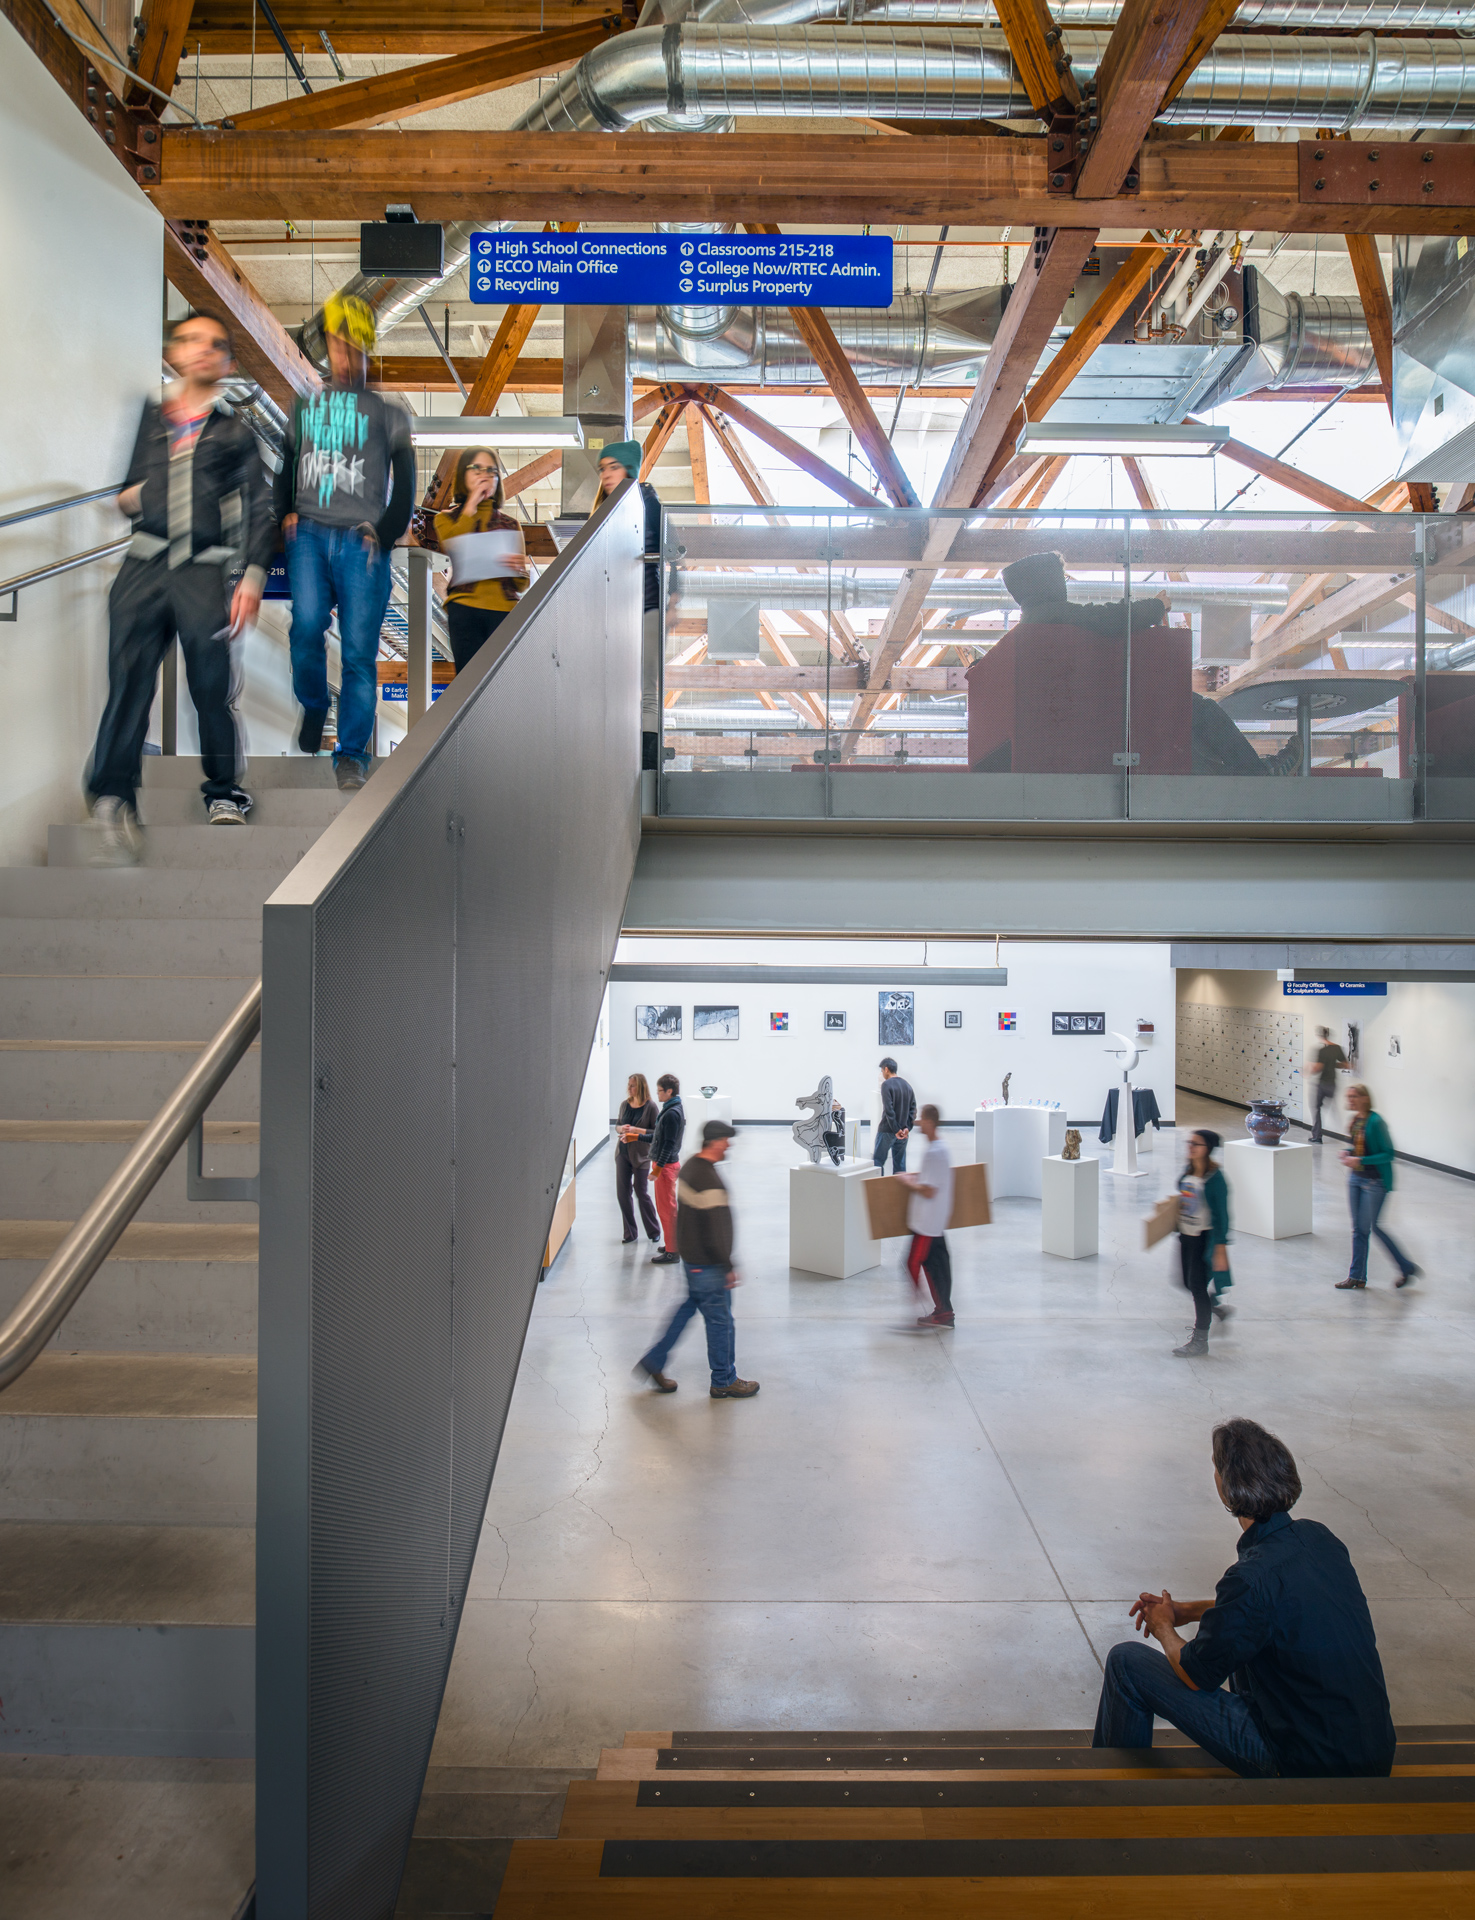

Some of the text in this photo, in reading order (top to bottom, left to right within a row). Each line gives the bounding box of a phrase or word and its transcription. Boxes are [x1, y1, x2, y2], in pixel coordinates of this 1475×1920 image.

[495, 241, 667, 258] High School Connections
[697, 242, 834, 257] Classrooms 215-218
[495, 260, 618, 274] ECCO Main Office
[697, 261, 881, 278] College Now/RTEC Admin.
[495, 277, 560, 295] Recycling
[697, 279, 812, 297] Surplus Property
[319, 391, 358, 409] LIKE
[329, 408, 369, 448] WAY
[313, 424, 343, 453] YOU
[267, 568, 285, 576] -218
